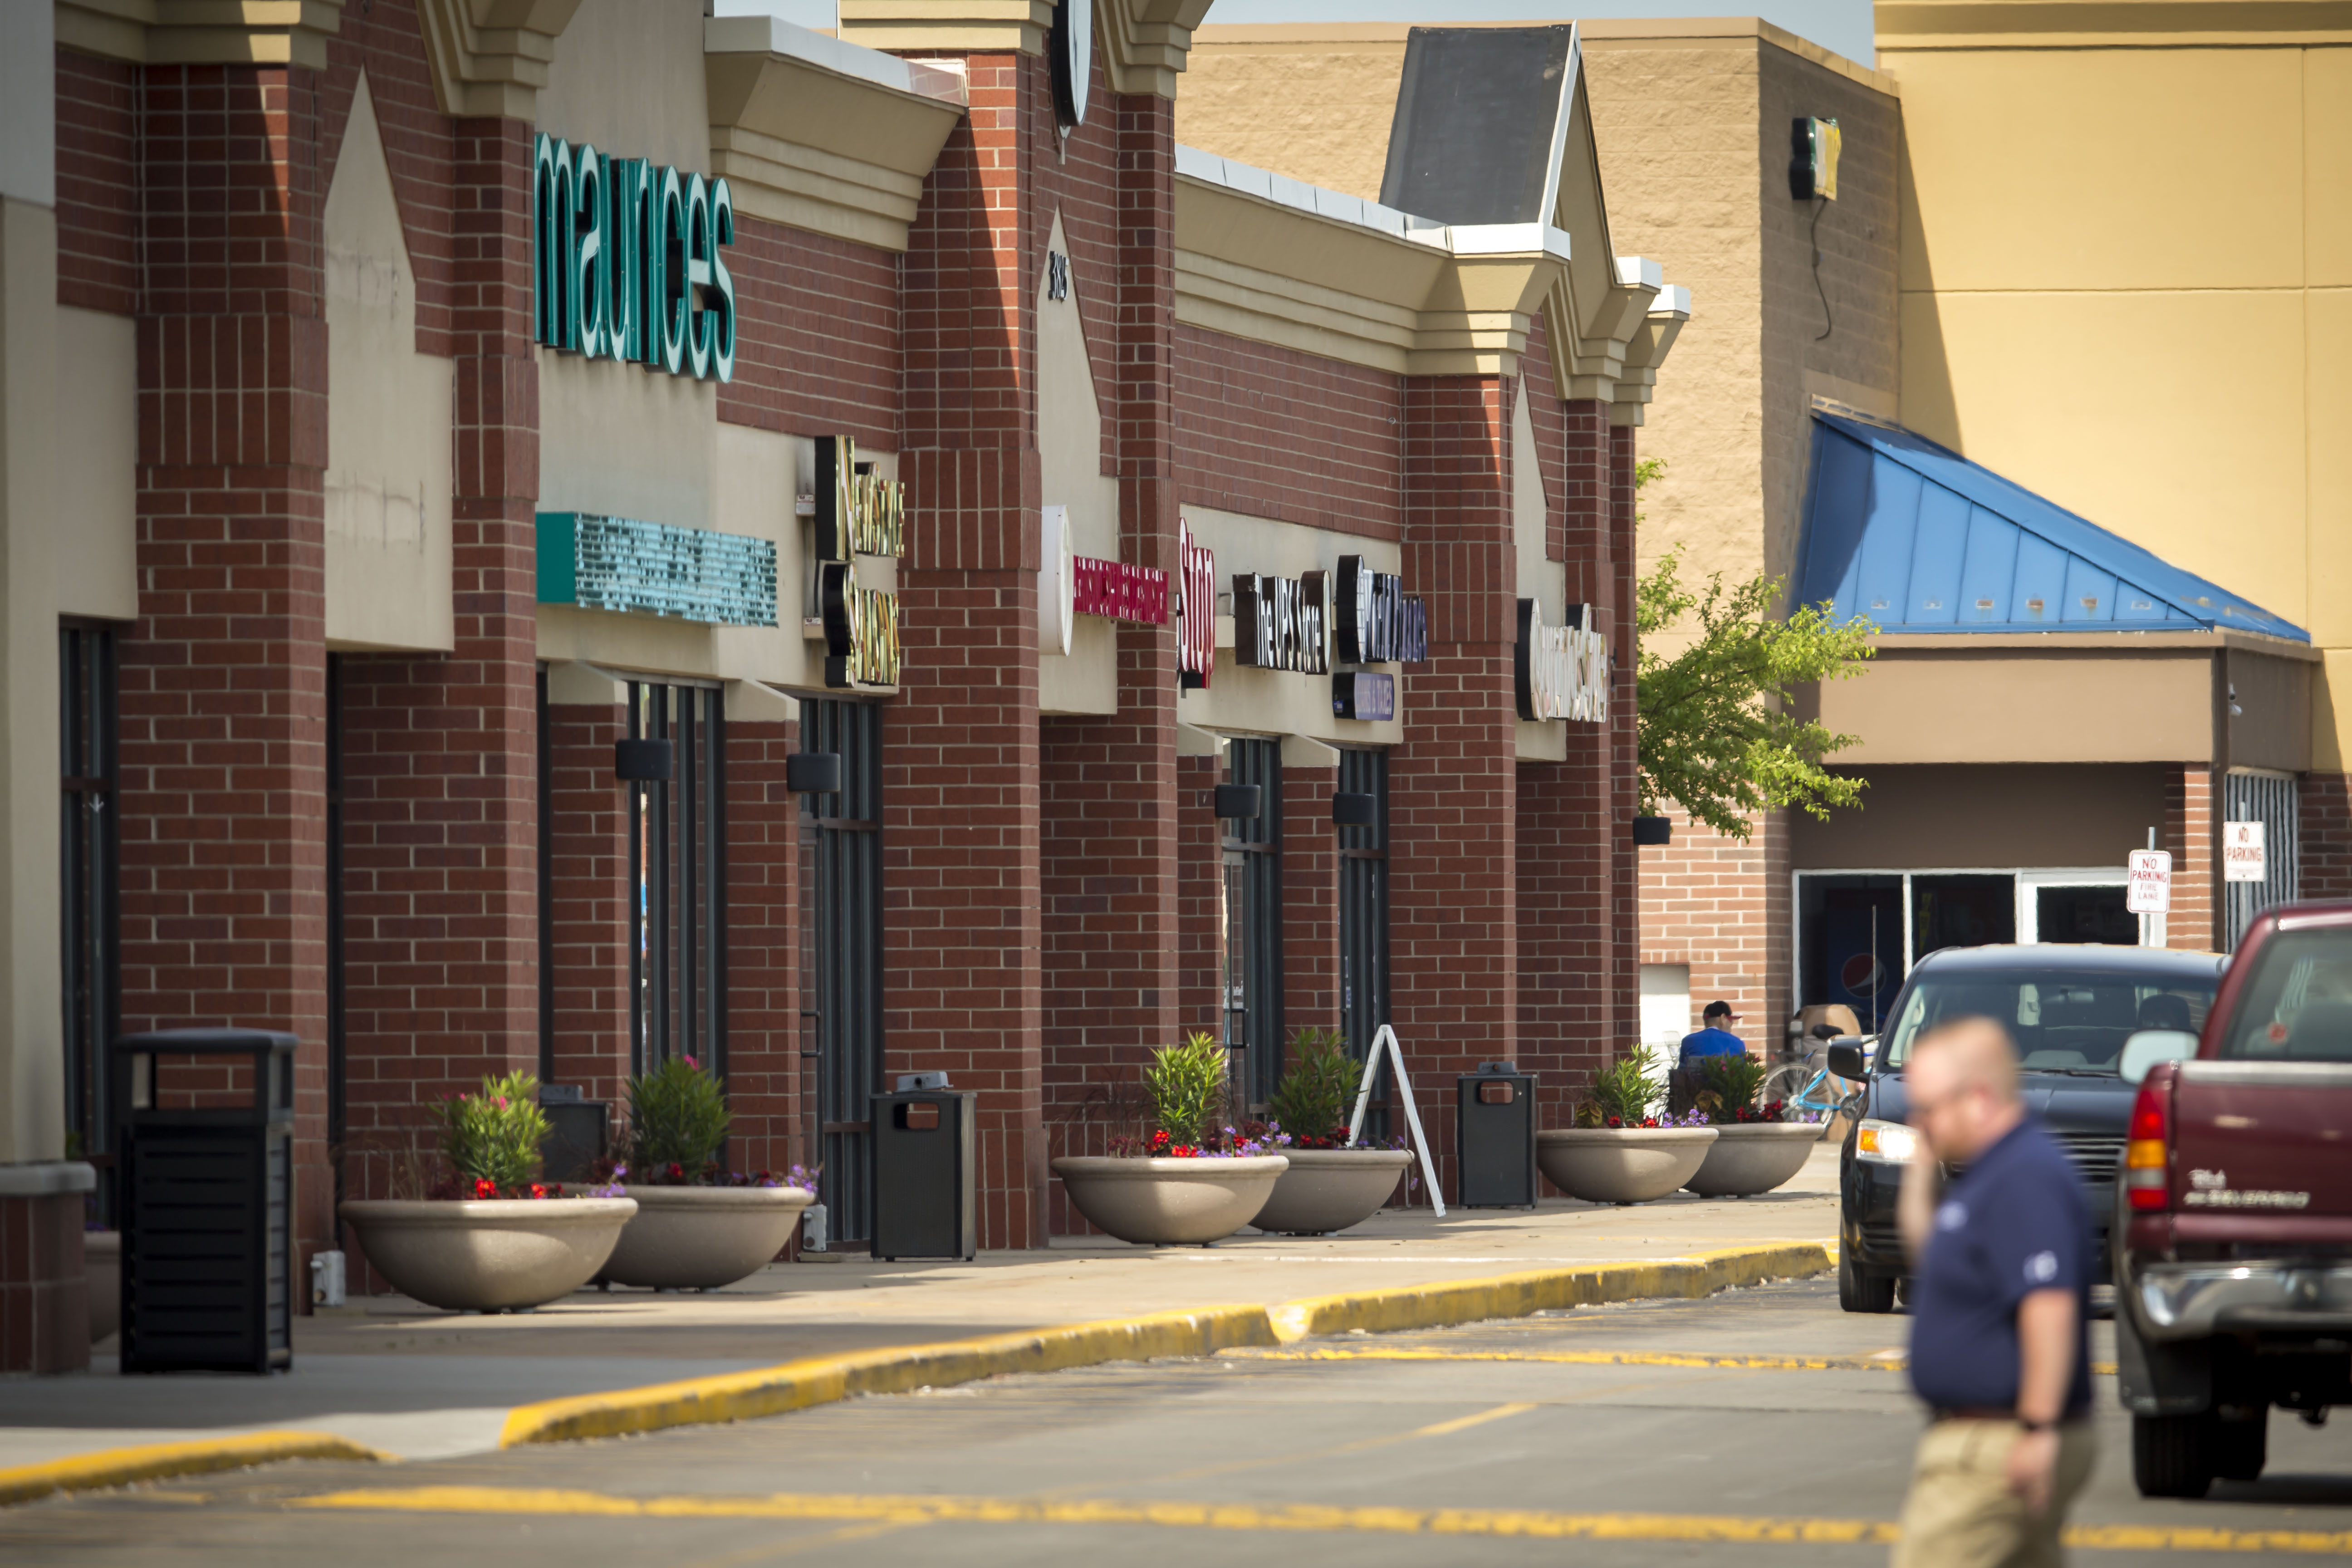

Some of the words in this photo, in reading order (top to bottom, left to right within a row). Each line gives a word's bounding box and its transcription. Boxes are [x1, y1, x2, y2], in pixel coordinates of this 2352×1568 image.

[534, 132, 736, 383] maurices
[1177, 517, 1215, 689] Stop
[1254, 573, 1274, 667] The
[1275, 576, 1294, 671] UPS
[1296, 579, 1321, 673] Store
[2239, 827, 2249, 843] NO
[2226, 847, 2262, 862] PARKING
[2142, 858, 2157, 869] NO
[2132, 870, 2167, 883] PARKING
[2140, 883, 2158, 891] FIRE
[2138, 892, 2159, 901] LANE
